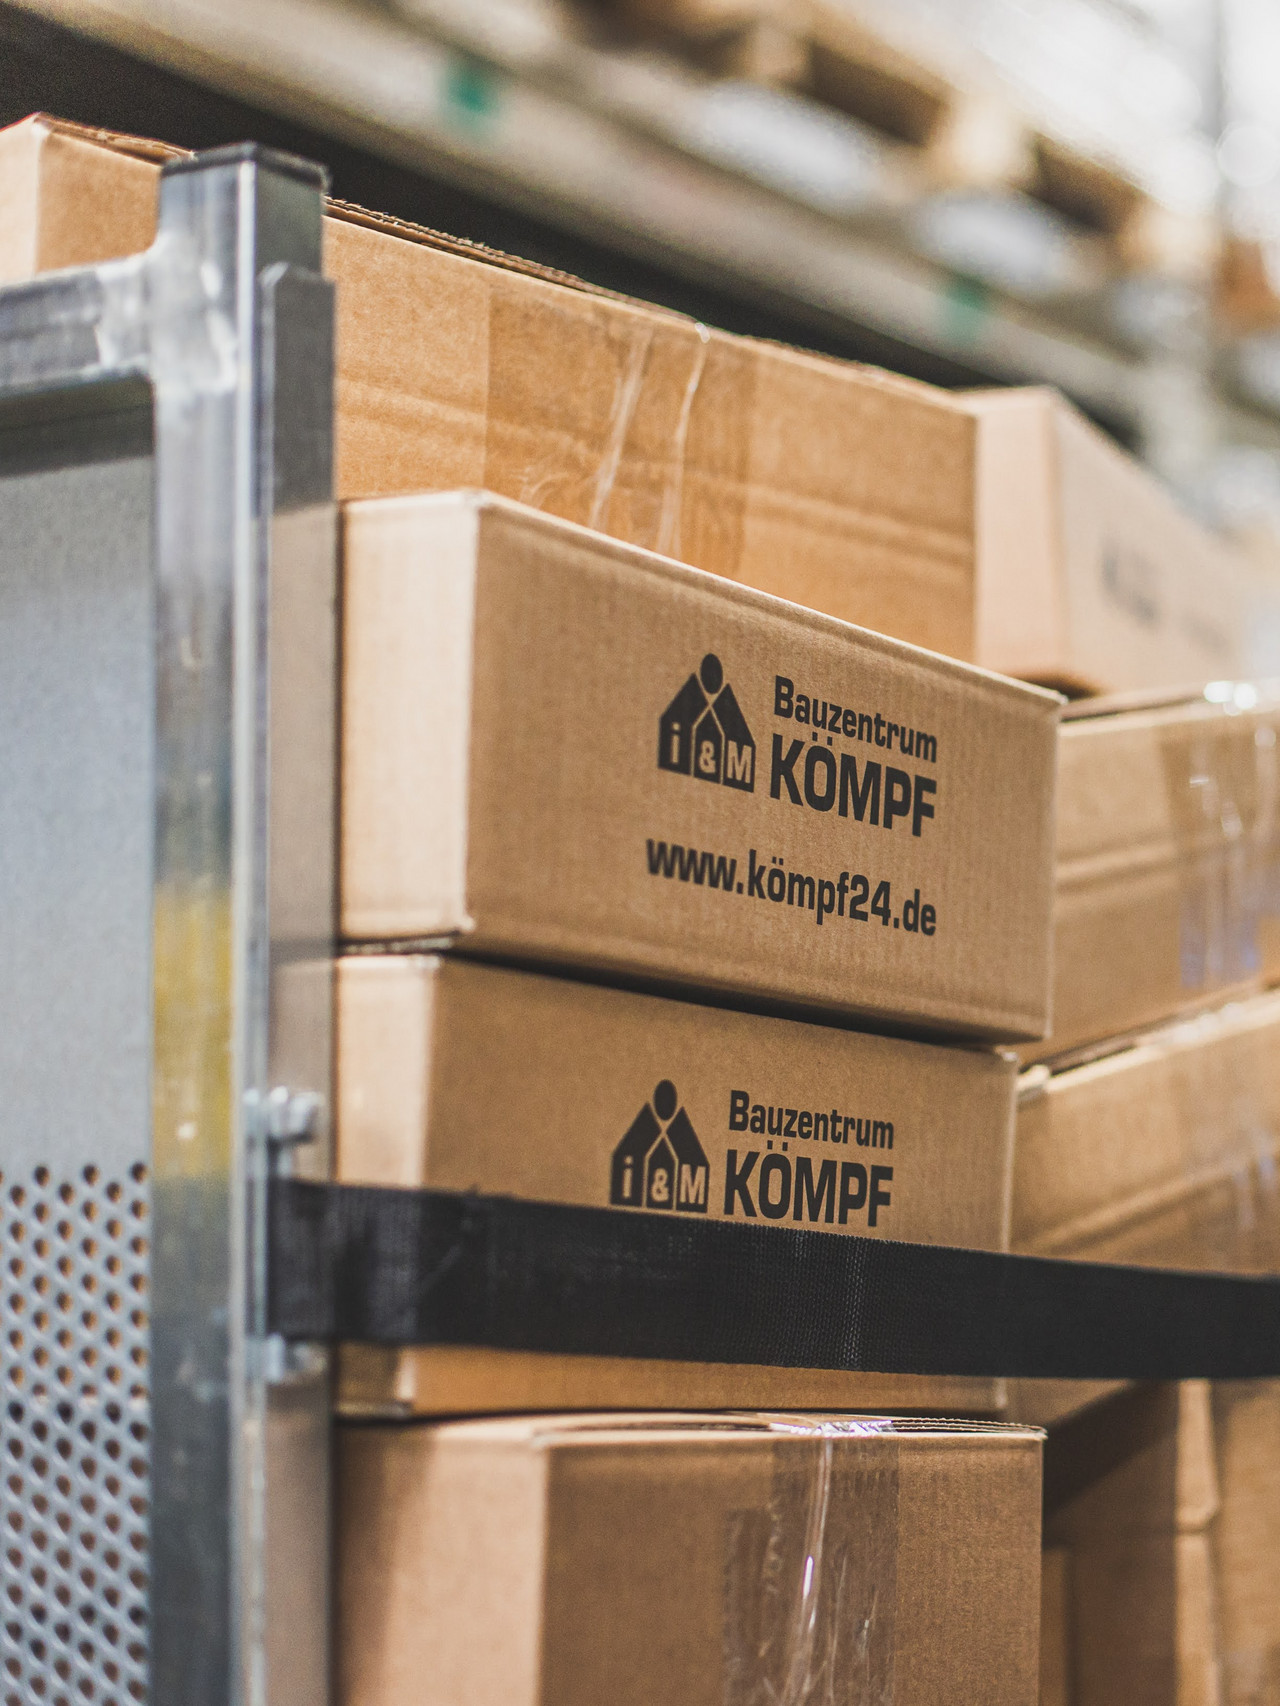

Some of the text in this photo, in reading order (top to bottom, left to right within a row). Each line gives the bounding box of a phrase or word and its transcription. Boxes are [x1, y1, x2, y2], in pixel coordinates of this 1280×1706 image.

[774, 674, 938, 764] Bauzentrum
[769, 731, 938, 837] KÖMPF
[646, 838, 937, 936] www.kömpf24.de
[728, 1089, 894, 1150] Bauzentrum
[723, 1140, 894, 1228] KÖMPF
